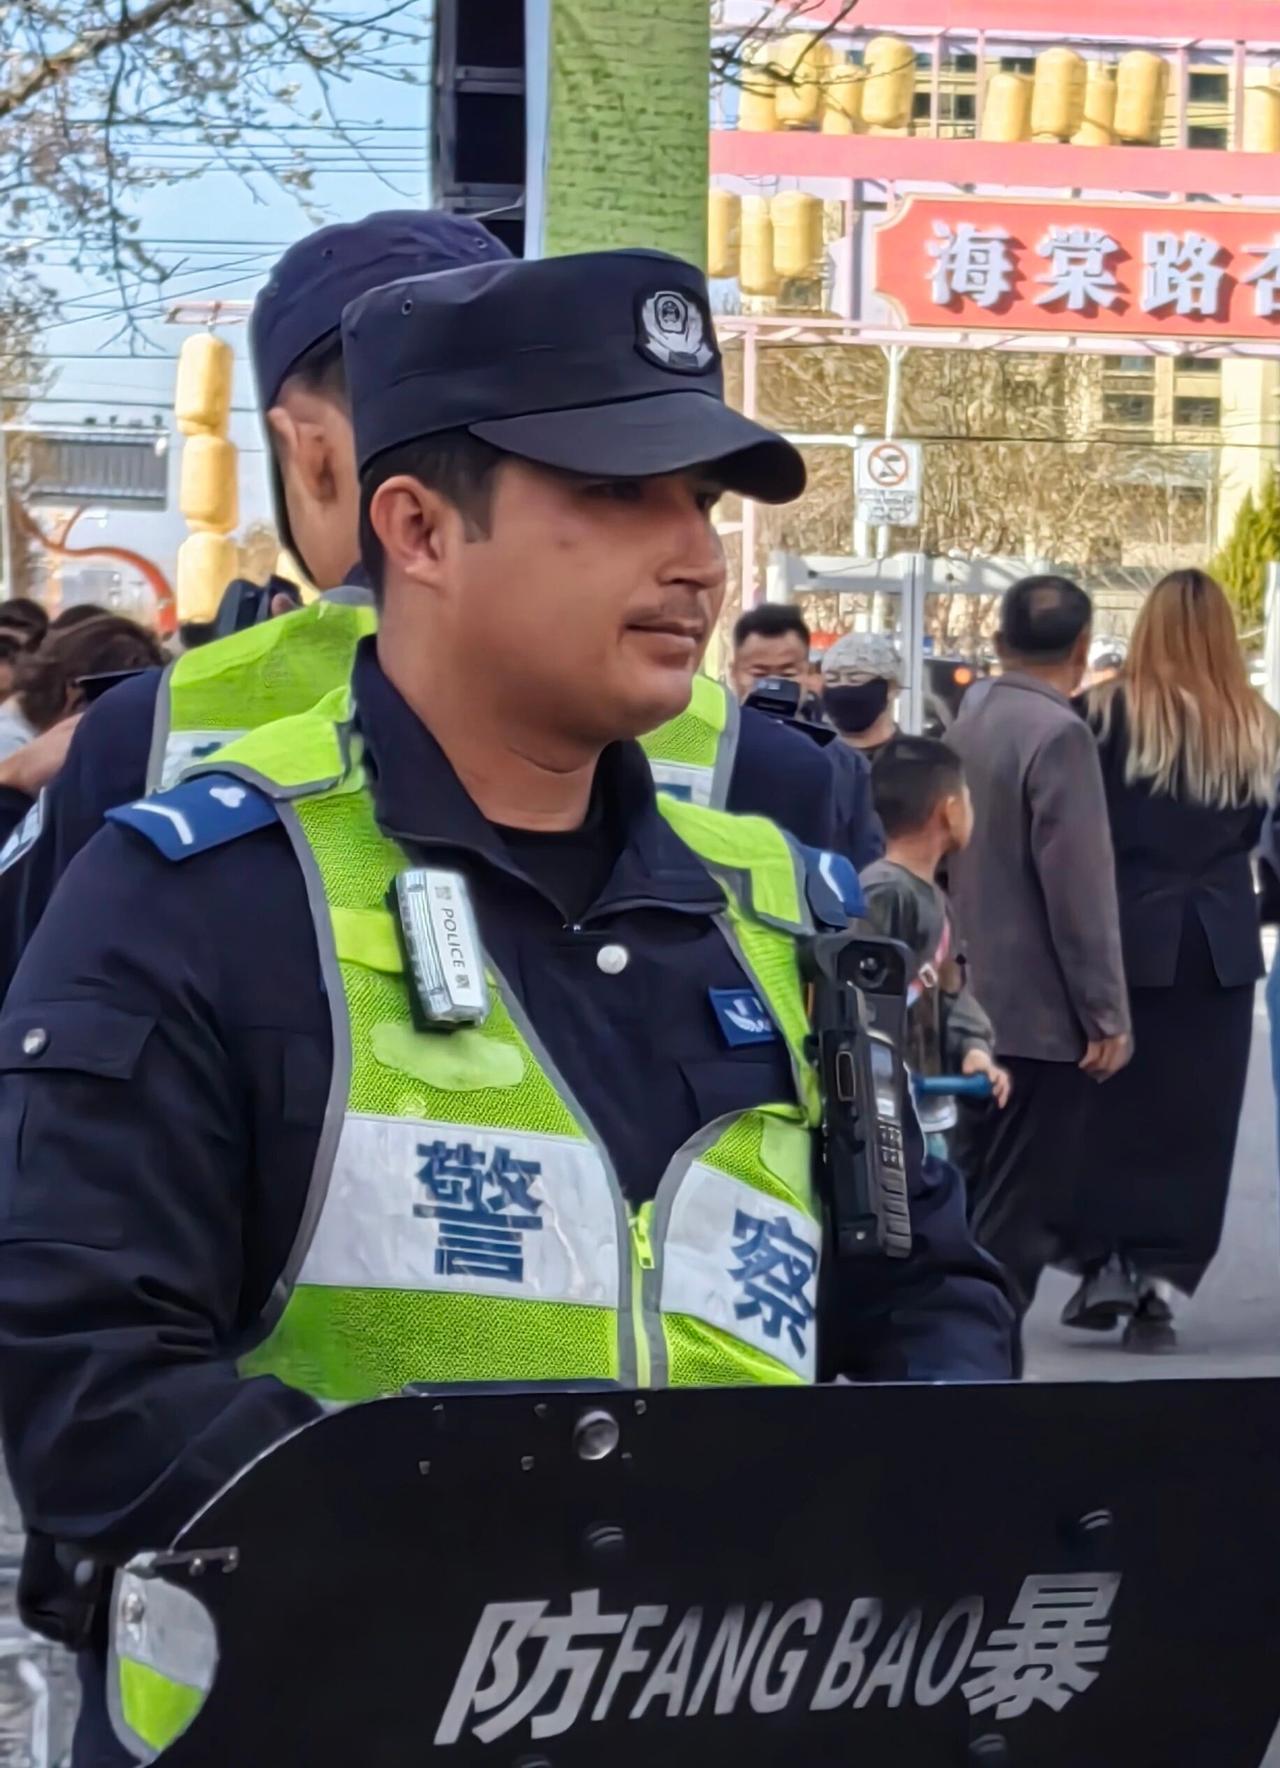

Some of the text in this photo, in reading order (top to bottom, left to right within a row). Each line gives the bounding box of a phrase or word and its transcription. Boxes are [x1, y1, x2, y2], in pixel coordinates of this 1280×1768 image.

[440, 907, 466, 969] POLICE
[412, 1139, 818, 1358] 警 察
[592, 1597, 824, 1722] FANG
[809, 1596, 985, 1712] BAO
